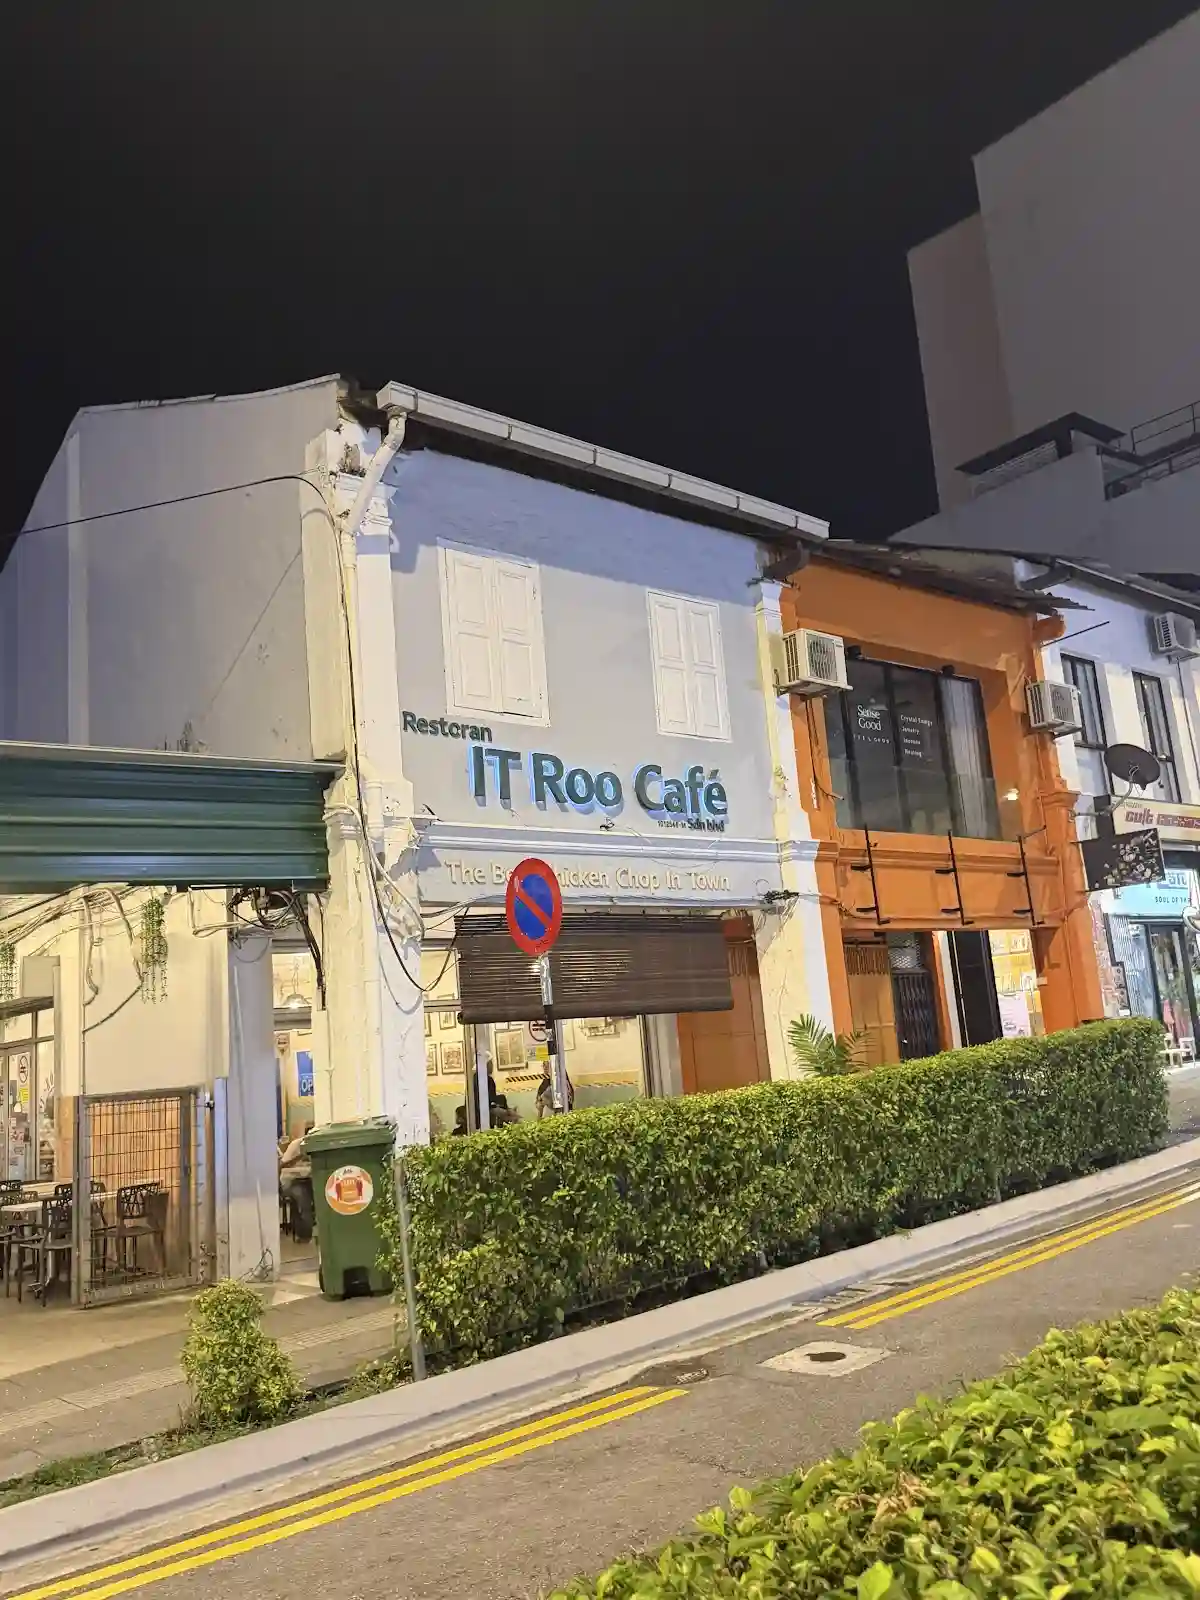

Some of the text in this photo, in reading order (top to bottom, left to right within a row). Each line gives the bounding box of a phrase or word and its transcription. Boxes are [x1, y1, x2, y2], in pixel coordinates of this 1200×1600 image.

[402, 710, 493, 743] Restoran
[857, 704, 881, 719] Sense
[858, 717, 882, 731] Good
[471, 745, 728, 816] IT Roo Café
[443, 859, 487, 885] The
[554, 863, 611, 889] hicken
[615, 865, 661, 894] Chop
[665, 870, 683, 891] In
[686, 871, 731, 892] Town
